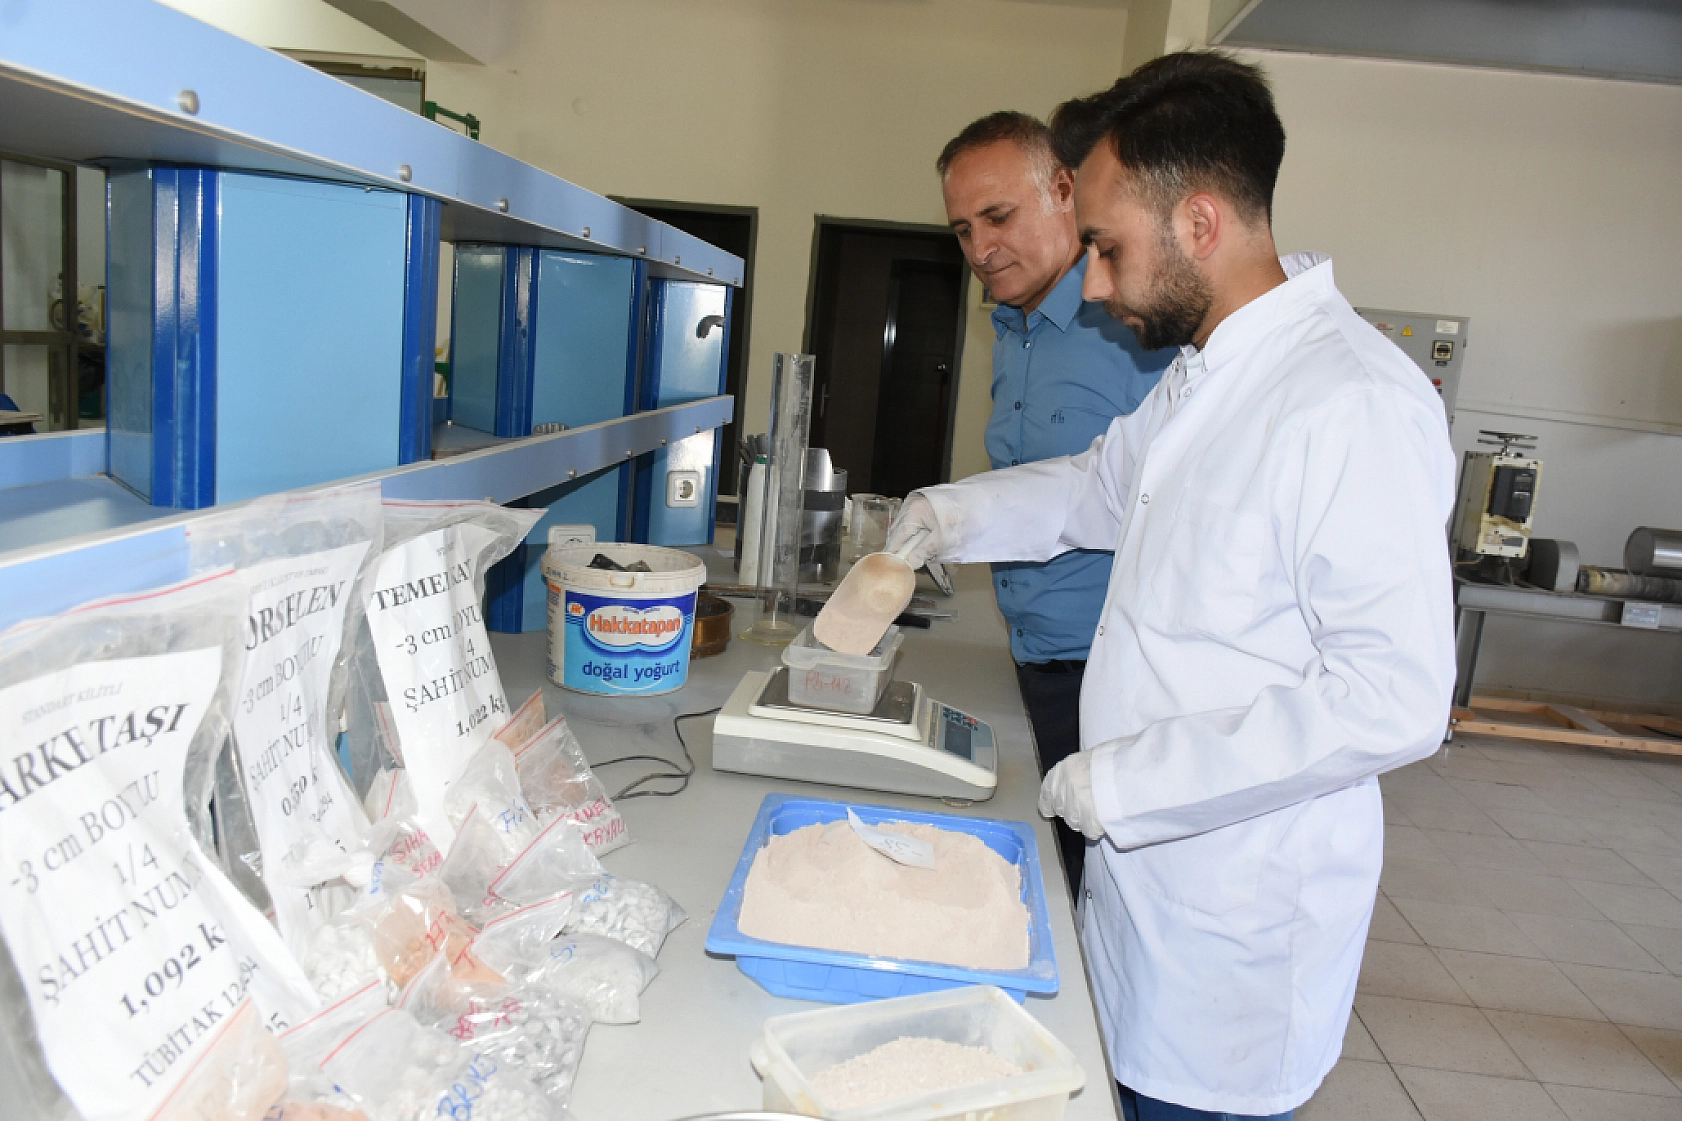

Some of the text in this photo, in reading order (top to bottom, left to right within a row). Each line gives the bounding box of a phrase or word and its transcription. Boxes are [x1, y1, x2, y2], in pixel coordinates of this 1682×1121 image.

[422, 625, 451, 645] cm
[589, 614, 683, 637] Hakkatapan
[582, 660, 680, 682] doğal yoğurt
[44, 834, 83, 871] cm
[113, 842, 159, 885] 1/4
[38, 909, 132, 1005] ŞAHİT
[121, 943, 201, 1018] 1,092
[130, 1000, 223, 1087] TÜBİTAK
